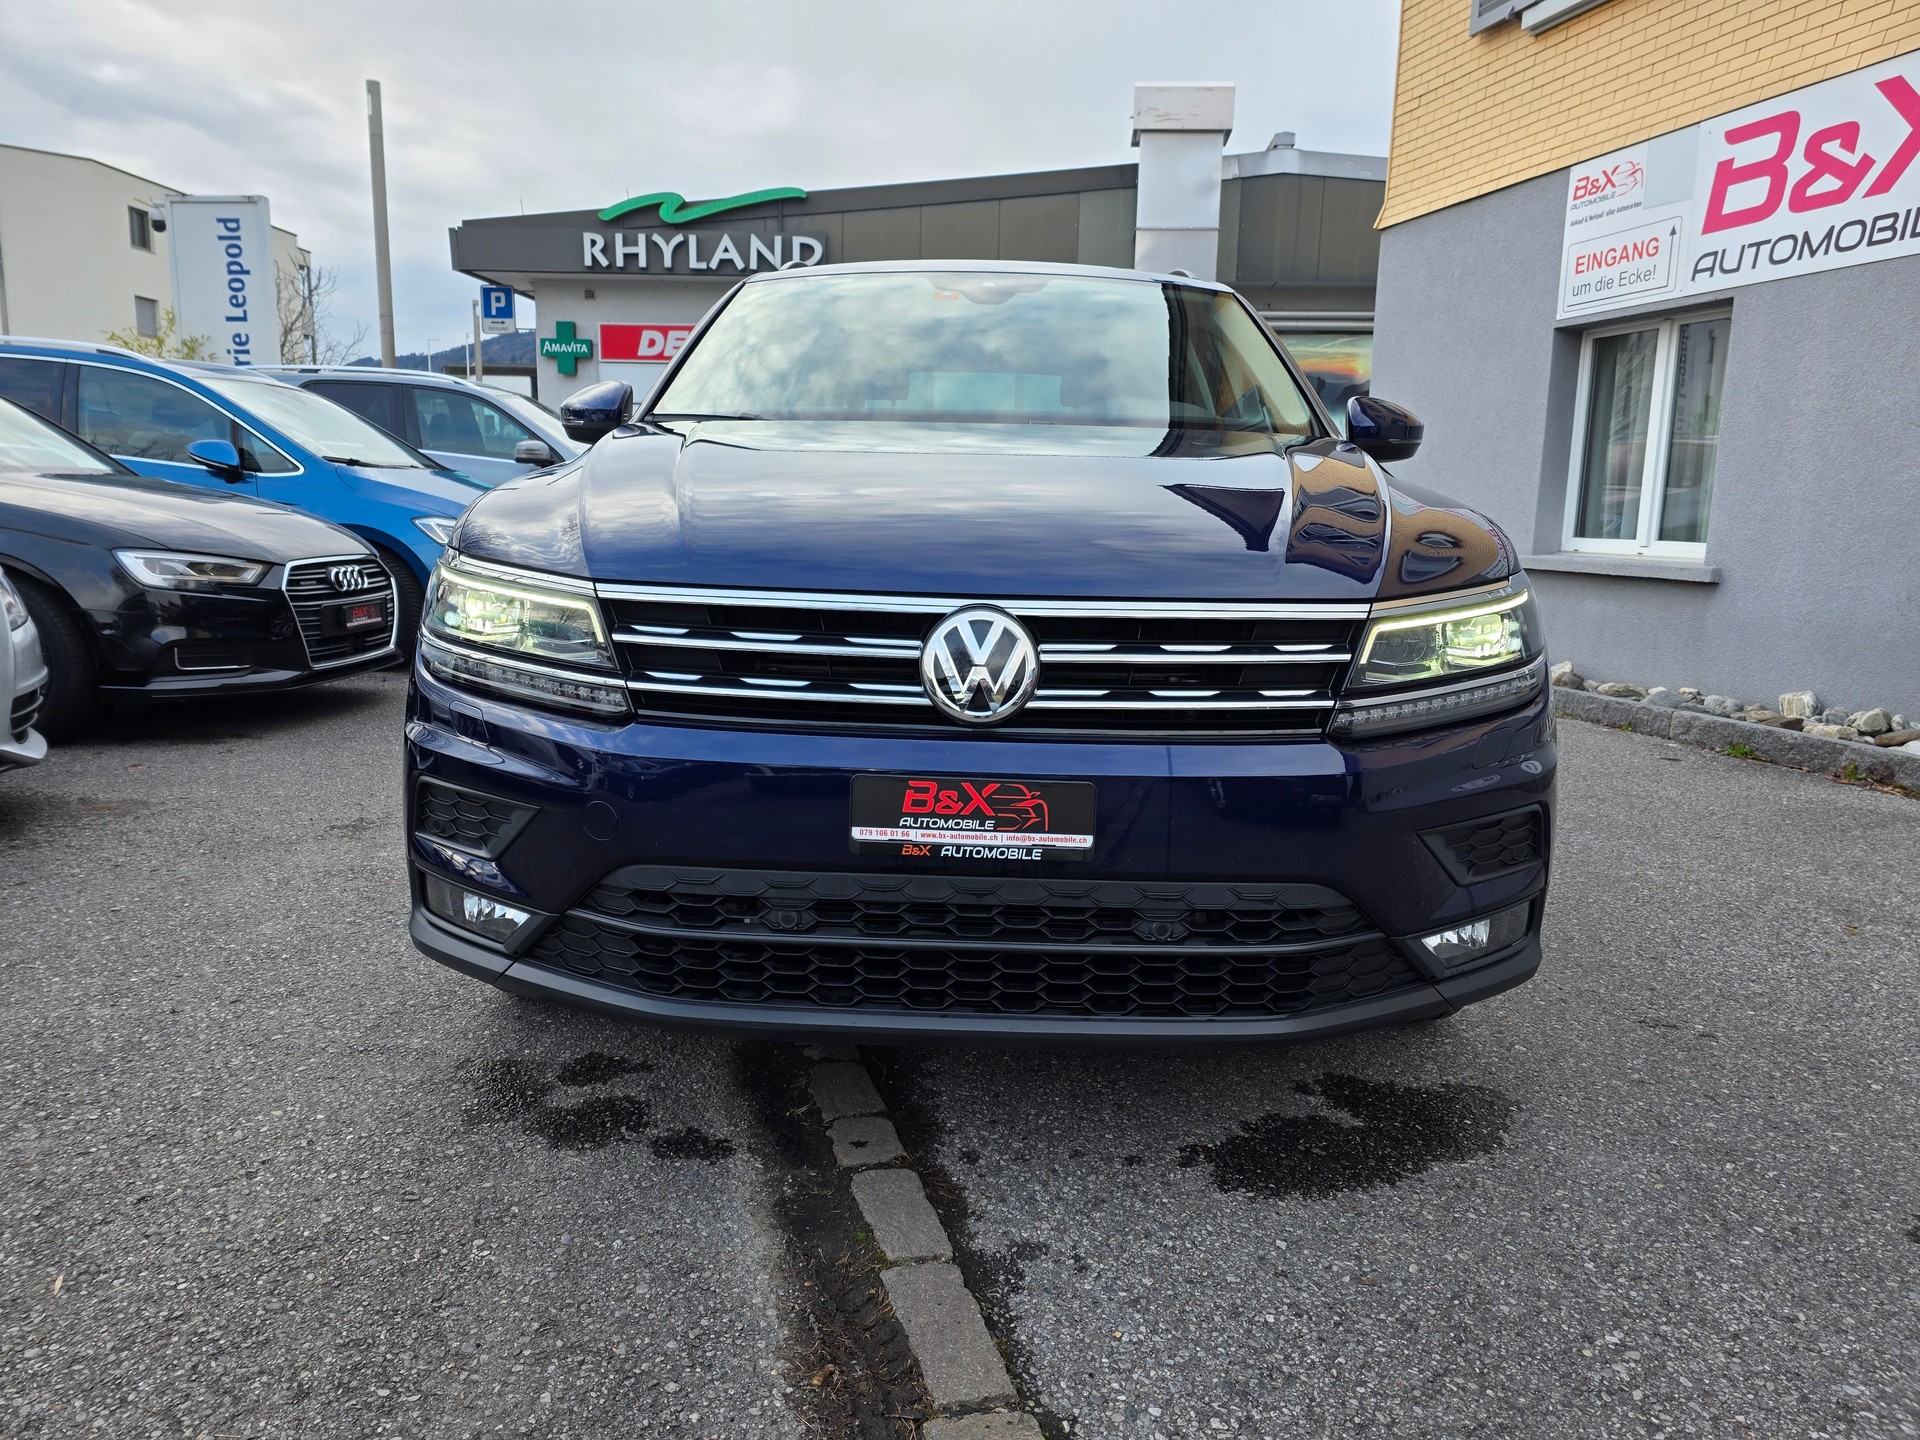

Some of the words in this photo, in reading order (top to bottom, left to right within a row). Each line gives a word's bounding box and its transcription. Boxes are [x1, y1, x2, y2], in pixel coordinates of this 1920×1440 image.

[1572, 165, 1620, 201] B&X
[1570, 191, 1616, 211] AUTOMOBILE
[583, 232, 823, 271] RHYLAND
[1575, 237, 1659, 274] EINGANG
[216, 217, 251, 322] Leopold
[1572, 283, 1591, 297] um
[1595, 275, 1614, 292] die
[1618, 264, 1657, 287] Ecke!
[490, 291, 506, 316] P
[902, 780, 1001, 816] B&X
[859, 828, 873, 836] 079
[875, 829, 888, 837] 106
[920, 831, 998, 841] www.bx-automobile.ch
[1006, 834, 1088, 844] info@bx-automobile.ch
[899, 817, 995, 830] AUTOMOBILE
[901, 844, 932, 856] B&X
[940, 846, 1042, 860] AUTOMOBILE
